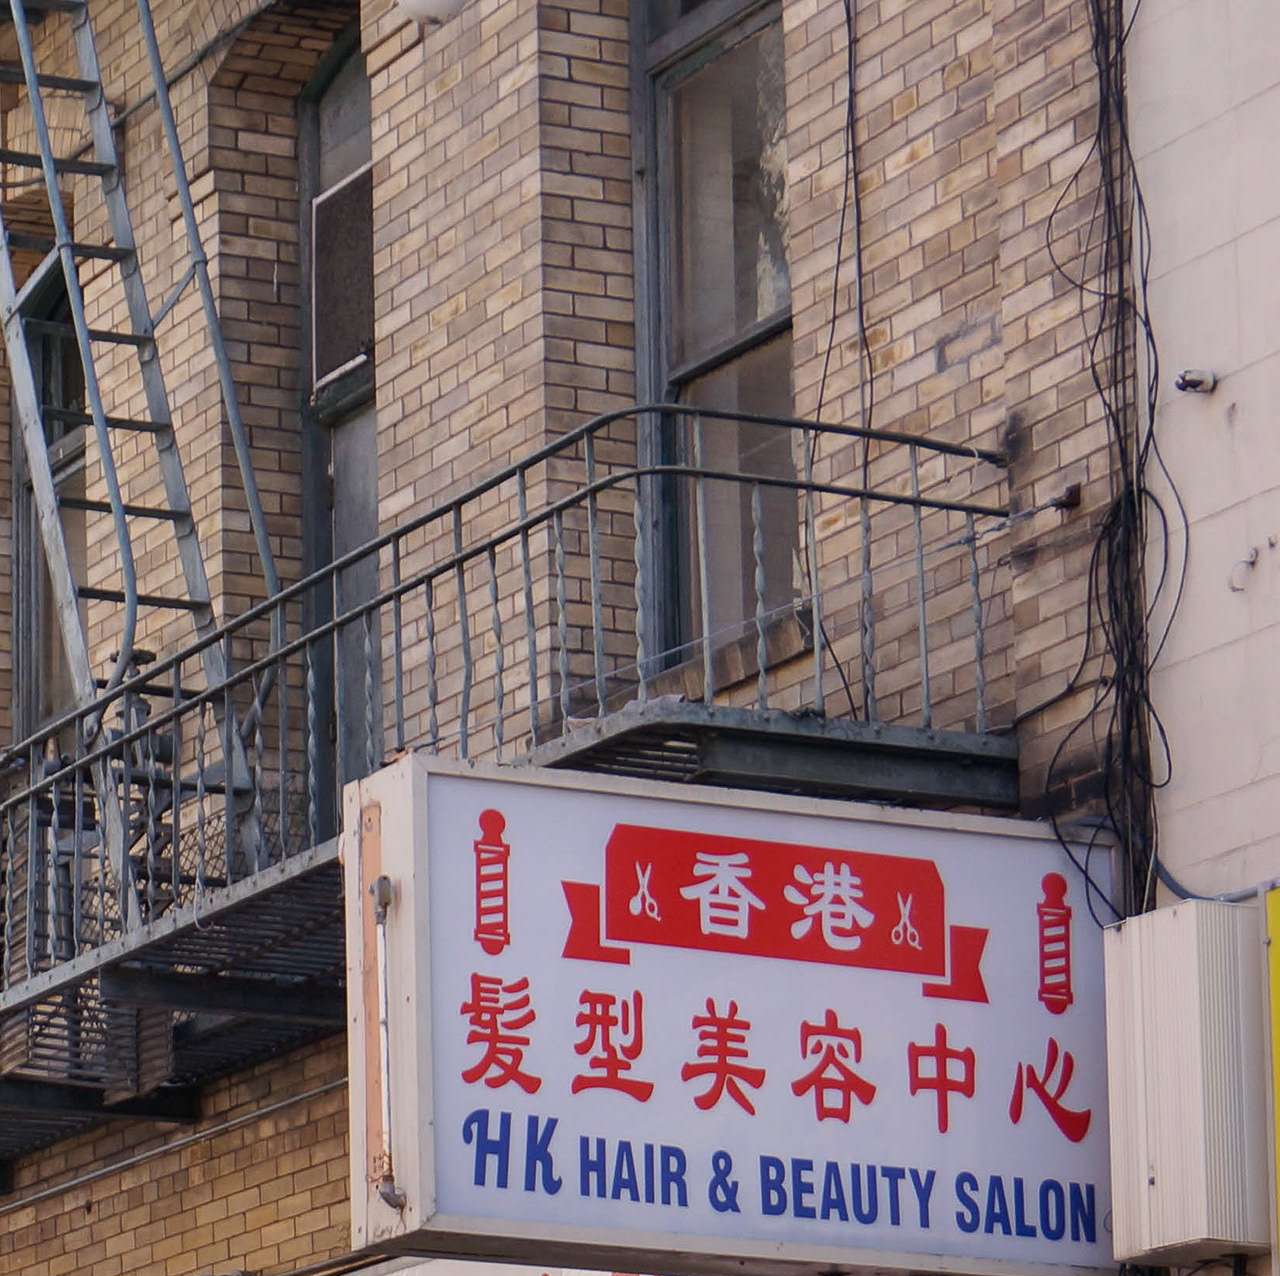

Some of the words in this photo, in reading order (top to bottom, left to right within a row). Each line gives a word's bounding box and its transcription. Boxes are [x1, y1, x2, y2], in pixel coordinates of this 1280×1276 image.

[680, 851, 875, 951] 香港
[462, 1107, 563, 1196] HK
[579, 1135, 689, 1203] HAIR
[708, 1152, 740, 1214] &
[760, 1153, 937, 1231] BEAUTY
[955, 1170, 1098, 1244] SALON
